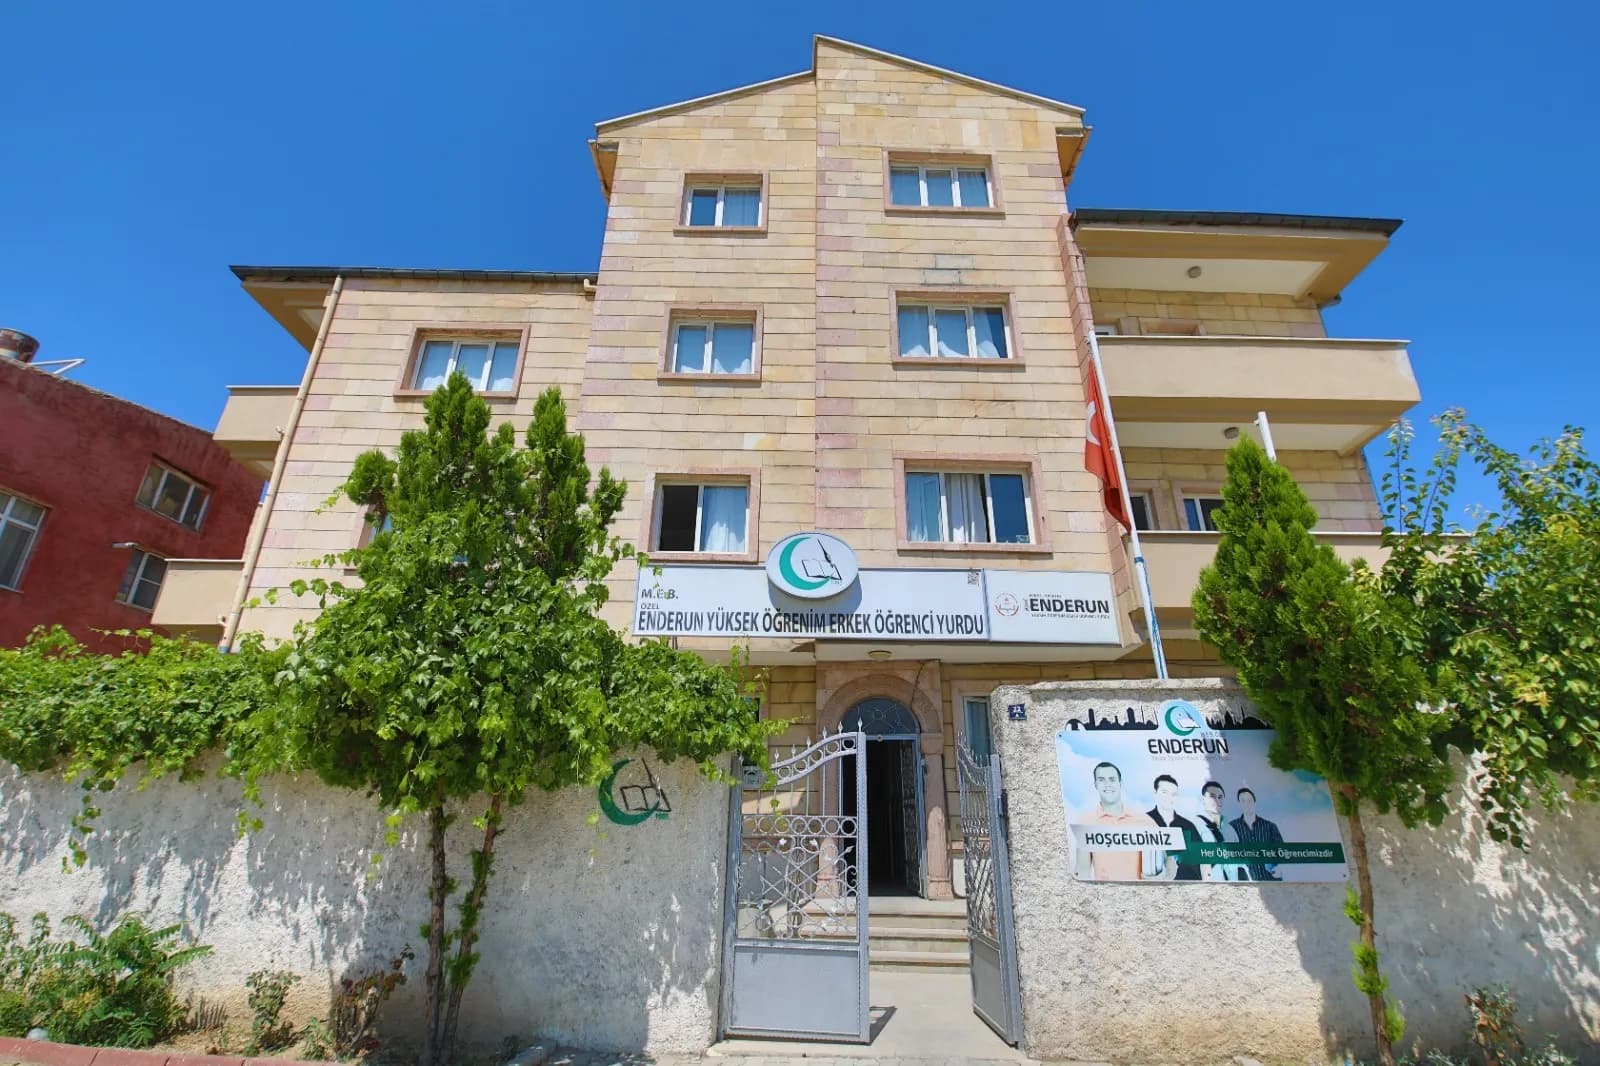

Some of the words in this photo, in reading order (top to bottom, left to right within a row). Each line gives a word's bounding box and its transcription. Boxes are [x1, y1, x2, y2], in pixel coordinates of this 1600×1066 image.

[640, 588, 679, 600] M.EB.
[1029, 598, 1110, 614] ENDERUN
[638, 610, 704, 632] ENDERUN
[707, 606, 760, 632] YÜKSEK
[762, 607, 826, 633] ÖĞRENİM
[829, 612, 873, 634] ERKEK
[874, 608, 934, 635] ÖĞRENCİ
[936, 613, 984, 635] YURDU
[1147, 738, 1229, 754] ENDERUN
[1085, 830, 1172, 848] HOŞGELDİNİZ
[1200, 848, 1214, 858] Her
[1216, 847, 1260, 860] Öğrencimiz
[1261, 849, 1277, 858] Tek
[1278, 847, 1333, 860] Öğrencimizdir
